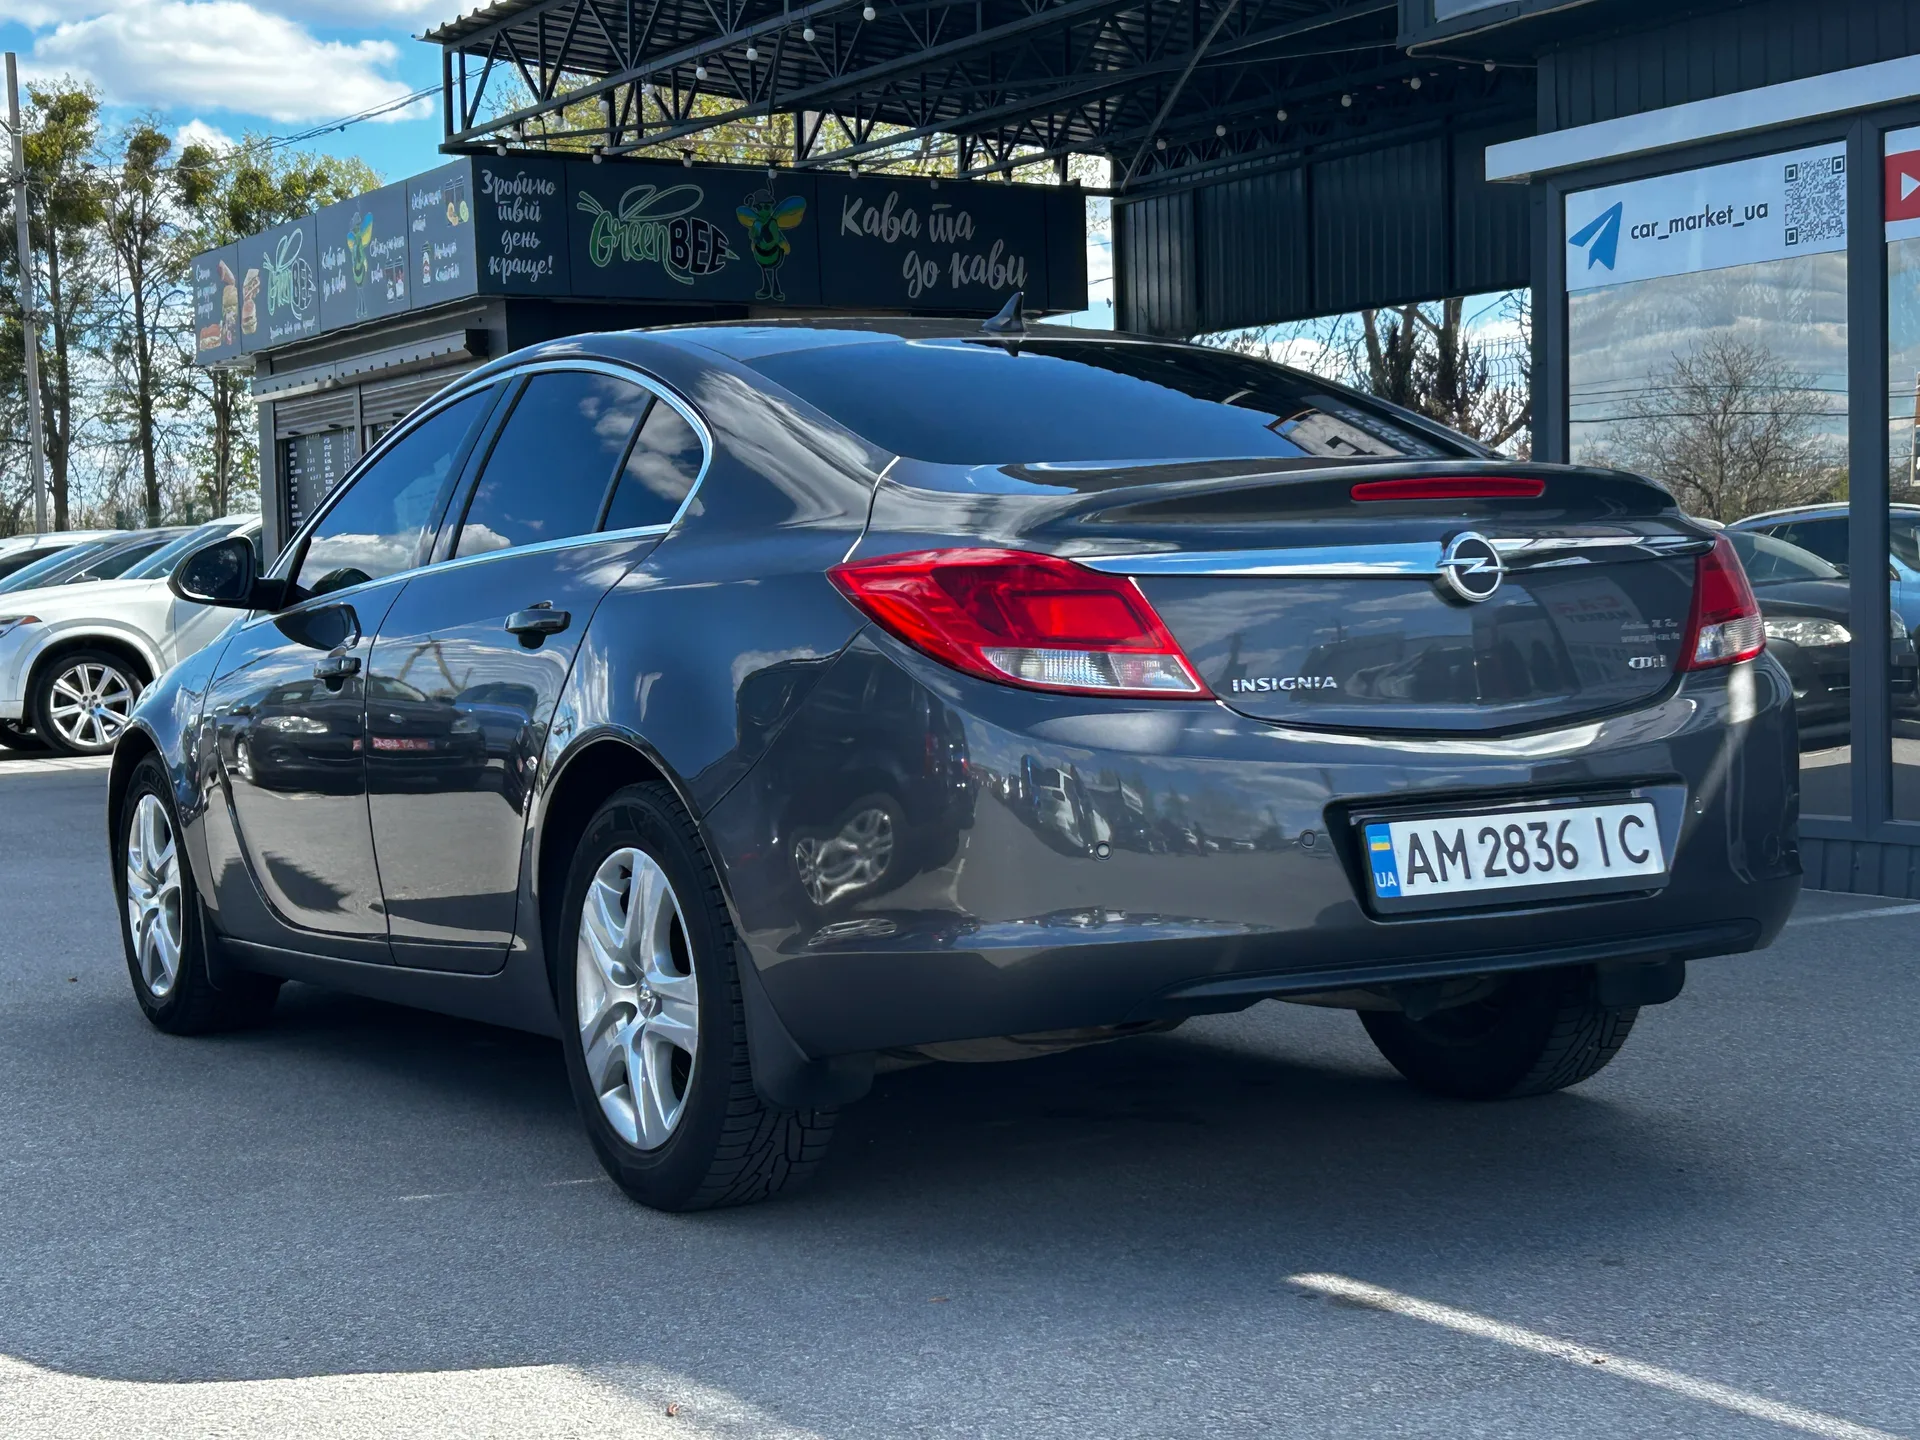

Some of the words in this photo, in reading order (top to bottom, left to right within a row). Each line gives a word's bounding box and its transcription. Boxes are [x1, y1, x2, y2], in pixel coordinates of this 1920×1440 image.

[481, 169, 557, 204] Зробимо
[497, 197, 542, 223] твій
[841, 190, 922, 243] Кава
[929, 203, 976, 243] та
[1630, 202, 1769, 240] car_market_ua
[501, 229, 541, 254] день
[488, 254, 553, 285] краще!
[903, 250, 940, 299] до
[948, 238, 1028, 290] кави
[1232, 676, 1338, 692] INSIGNIA
[1406, 828, 1471, 885] AM
[1477, 818, 1579, 878] 2836
[1595, 814, 1650, 868] IC
[1376, 871, 1397, 888] UA
